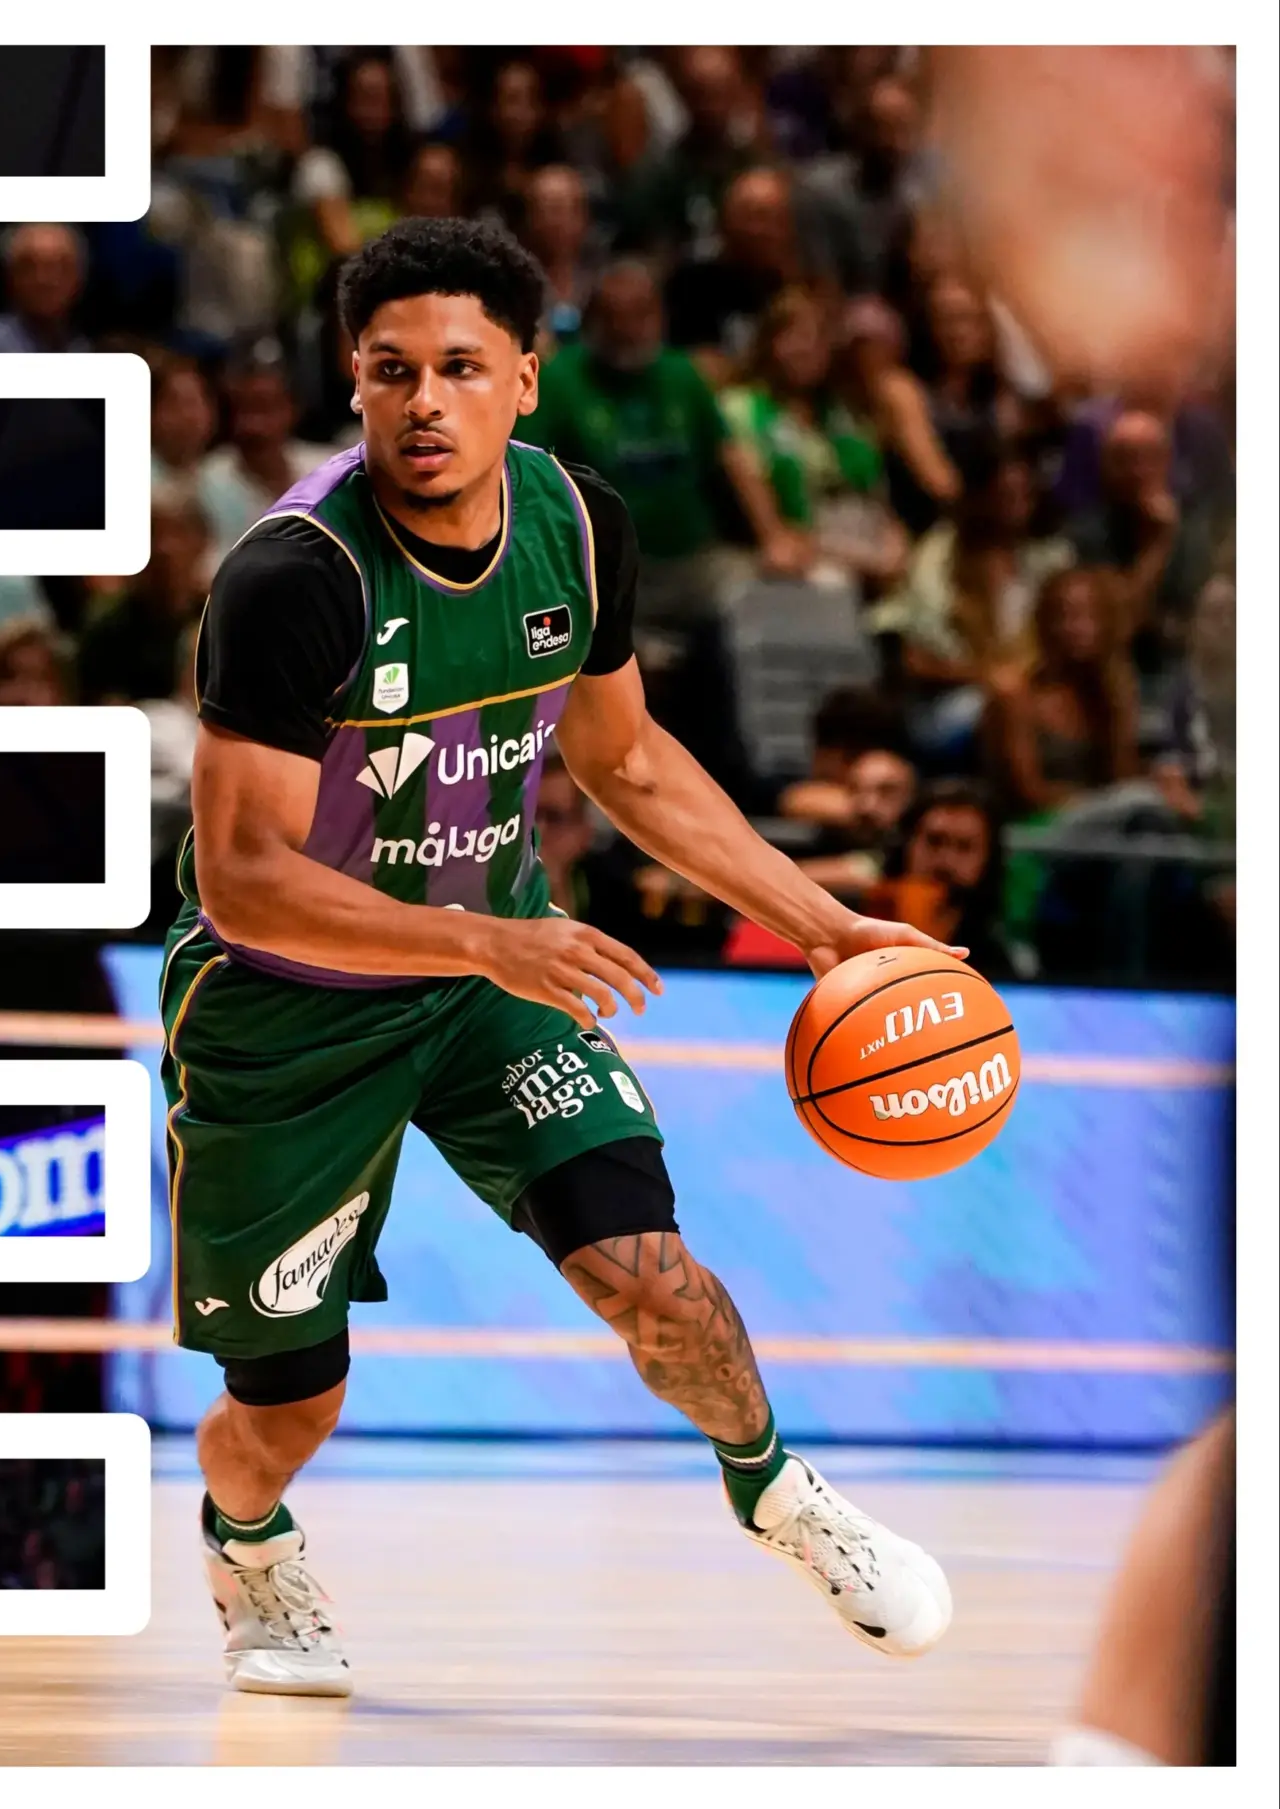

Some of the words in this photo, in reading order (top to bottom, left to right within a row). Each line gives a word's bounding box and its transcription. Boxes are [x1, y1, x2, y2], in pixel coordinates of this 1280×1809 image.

[531, 626, 550, 640] liga
[532, 632, 569, 651] endesa
[859, 1036, 886, 1061] NXT
[501, 1048, 545, 1095] sabor
[869, 1052, 1013, 1121] Wilson
